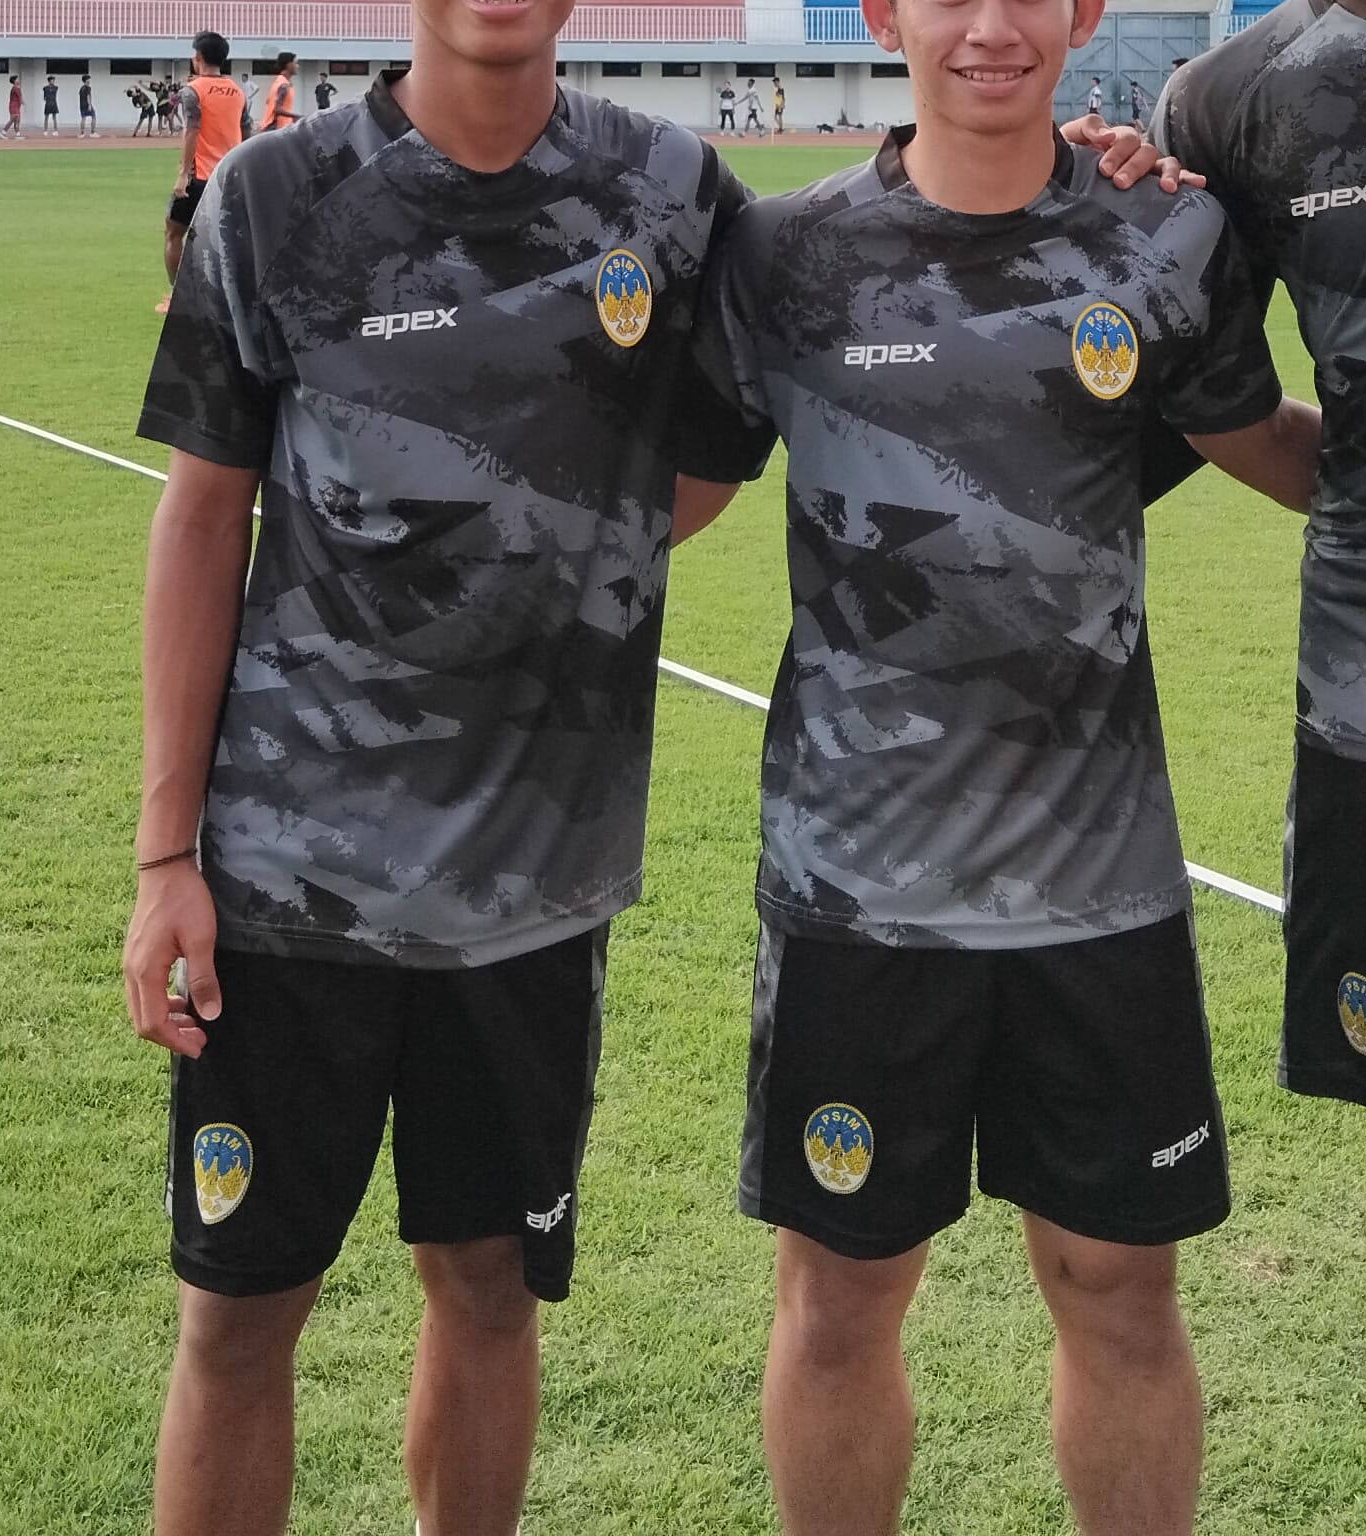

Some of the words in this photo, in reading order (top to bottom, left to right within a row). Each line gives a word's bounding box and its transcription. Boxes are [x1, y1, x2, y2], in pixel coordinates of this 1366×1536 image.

[606, 257, 636, 276] PSIM
[361, 306, 459, 340] apex
[1086, 311, 1122, 328] PSIM
[844, 343, 938, 371] apex
[821, 1111, 861, 1131] PSIM
[201, 1131, 243, 1151] PSIM
[1152, 1120, 1210, 1168] apex
